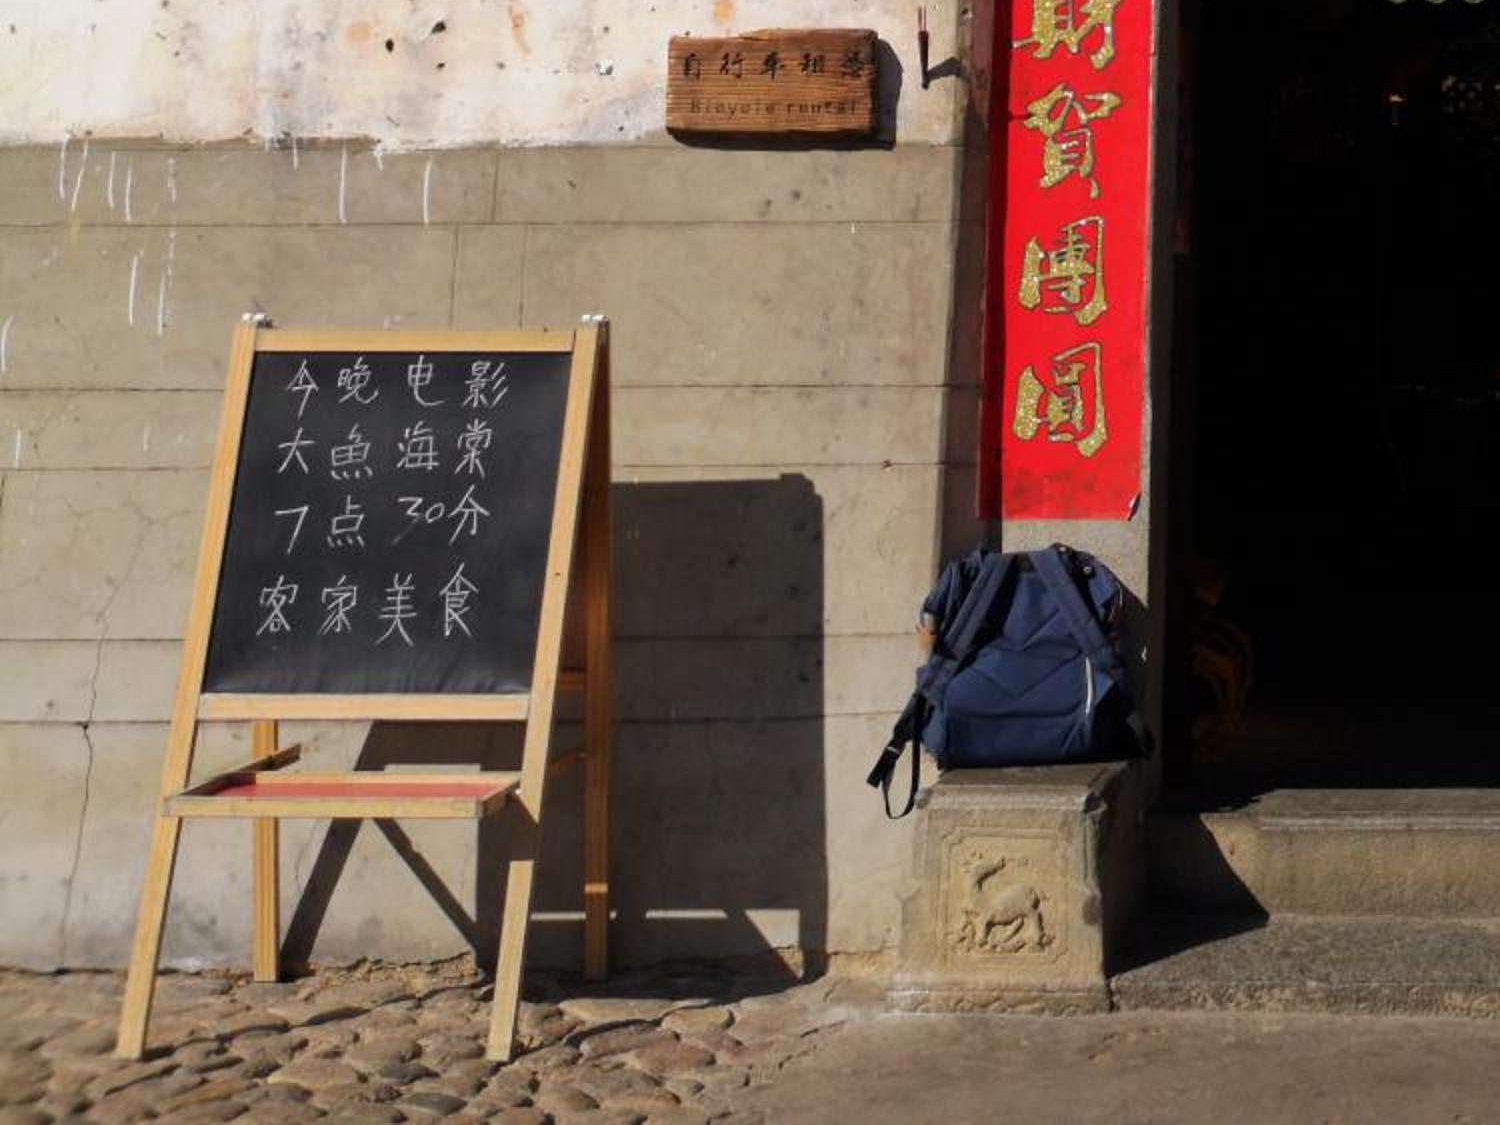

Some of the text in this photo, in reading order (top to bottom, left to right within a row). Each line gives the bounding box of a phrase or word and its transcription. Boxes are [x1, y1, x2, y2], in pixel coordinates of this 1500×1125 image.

[286, 355, 508, 419] 今晚电影
[256, 563, 479, 647] 客家美食
